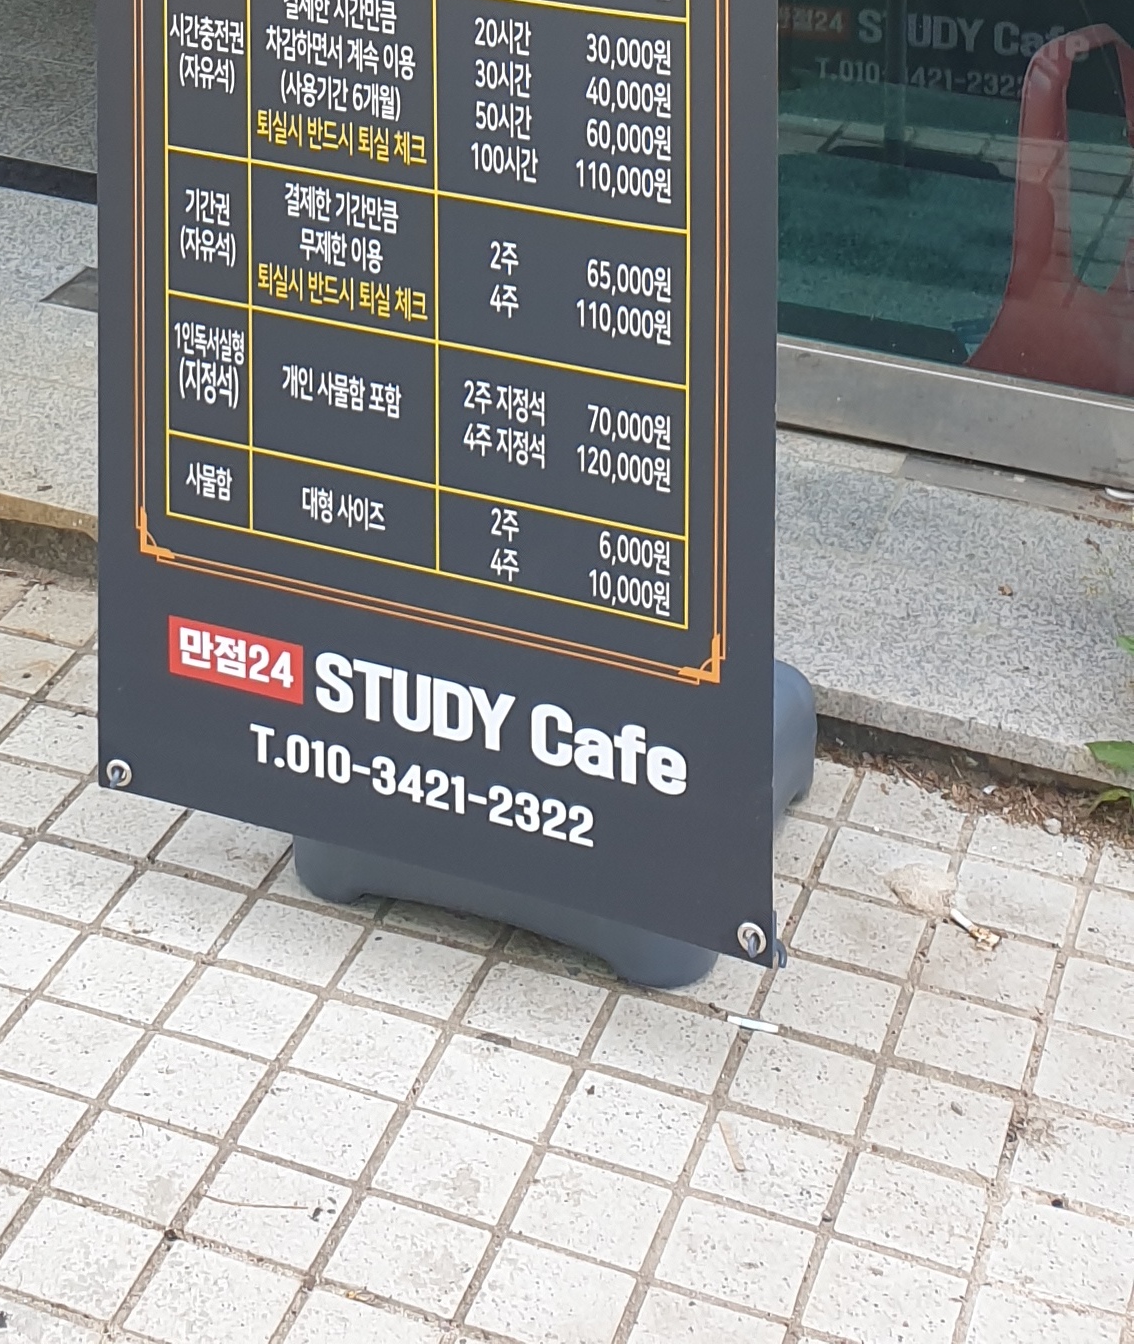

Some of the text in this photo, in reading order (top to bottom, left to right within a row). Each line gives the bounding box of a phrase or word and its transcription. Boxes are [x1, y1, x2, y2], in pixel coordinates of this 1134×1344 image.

[169, 13, 245, 56] 시간충전권
[265, 26, 416, 81] 차감하면서 계속 이용
[474, 18, 672, 76] 20시간 30,000원
[179, 52, 235, 94] (자유석)
[280, 71, 401, 121] (사용기간 6개월)
[475, 59, 672, 120] 30시간 40,000원
[256, 109, 427, 166] 퇴실시 반드시 퇴실 체크
[475, 102, 672, 162] 50시간 60,000원
[471, 143, 672, 204] 100시간 110,000원
[185, 188, 230, 228] 기간권
[284, 183, 398, 234] 결제한 기간만큼
[180, 232, 236, 268] (자유석)
[299, 228, 383, 274] 무제한 이용
[490, 240, 672, 302] 2주 65,000원
[257, 262, 427, 322] 퇴실시 반드시 퇴실 체크
[490, 284, 672, 346] 4주 110,000원
[174, 321, 245, 366] 1인독서실형
[179, 357, 239, 409] (지정석)
[282, 364, 402, 419] 개인 사물함 포함
[464, 379, 671, 453] 2주 지정석 70,000원
[185, 461, 232, 502] 사물함
[463, 421, 671, 494] 4주 지정석 120,000원
[301, 487, 385, 532] 대형 사이즈
[491, 506, 671, 576] 2주 6,000원
[490, 547, 671, 618] 4주 10,000원
[179, 627, 687, 795] 만점24 STUDY Cafe
[250, 723, 594, 847] T.010-3421-2322
